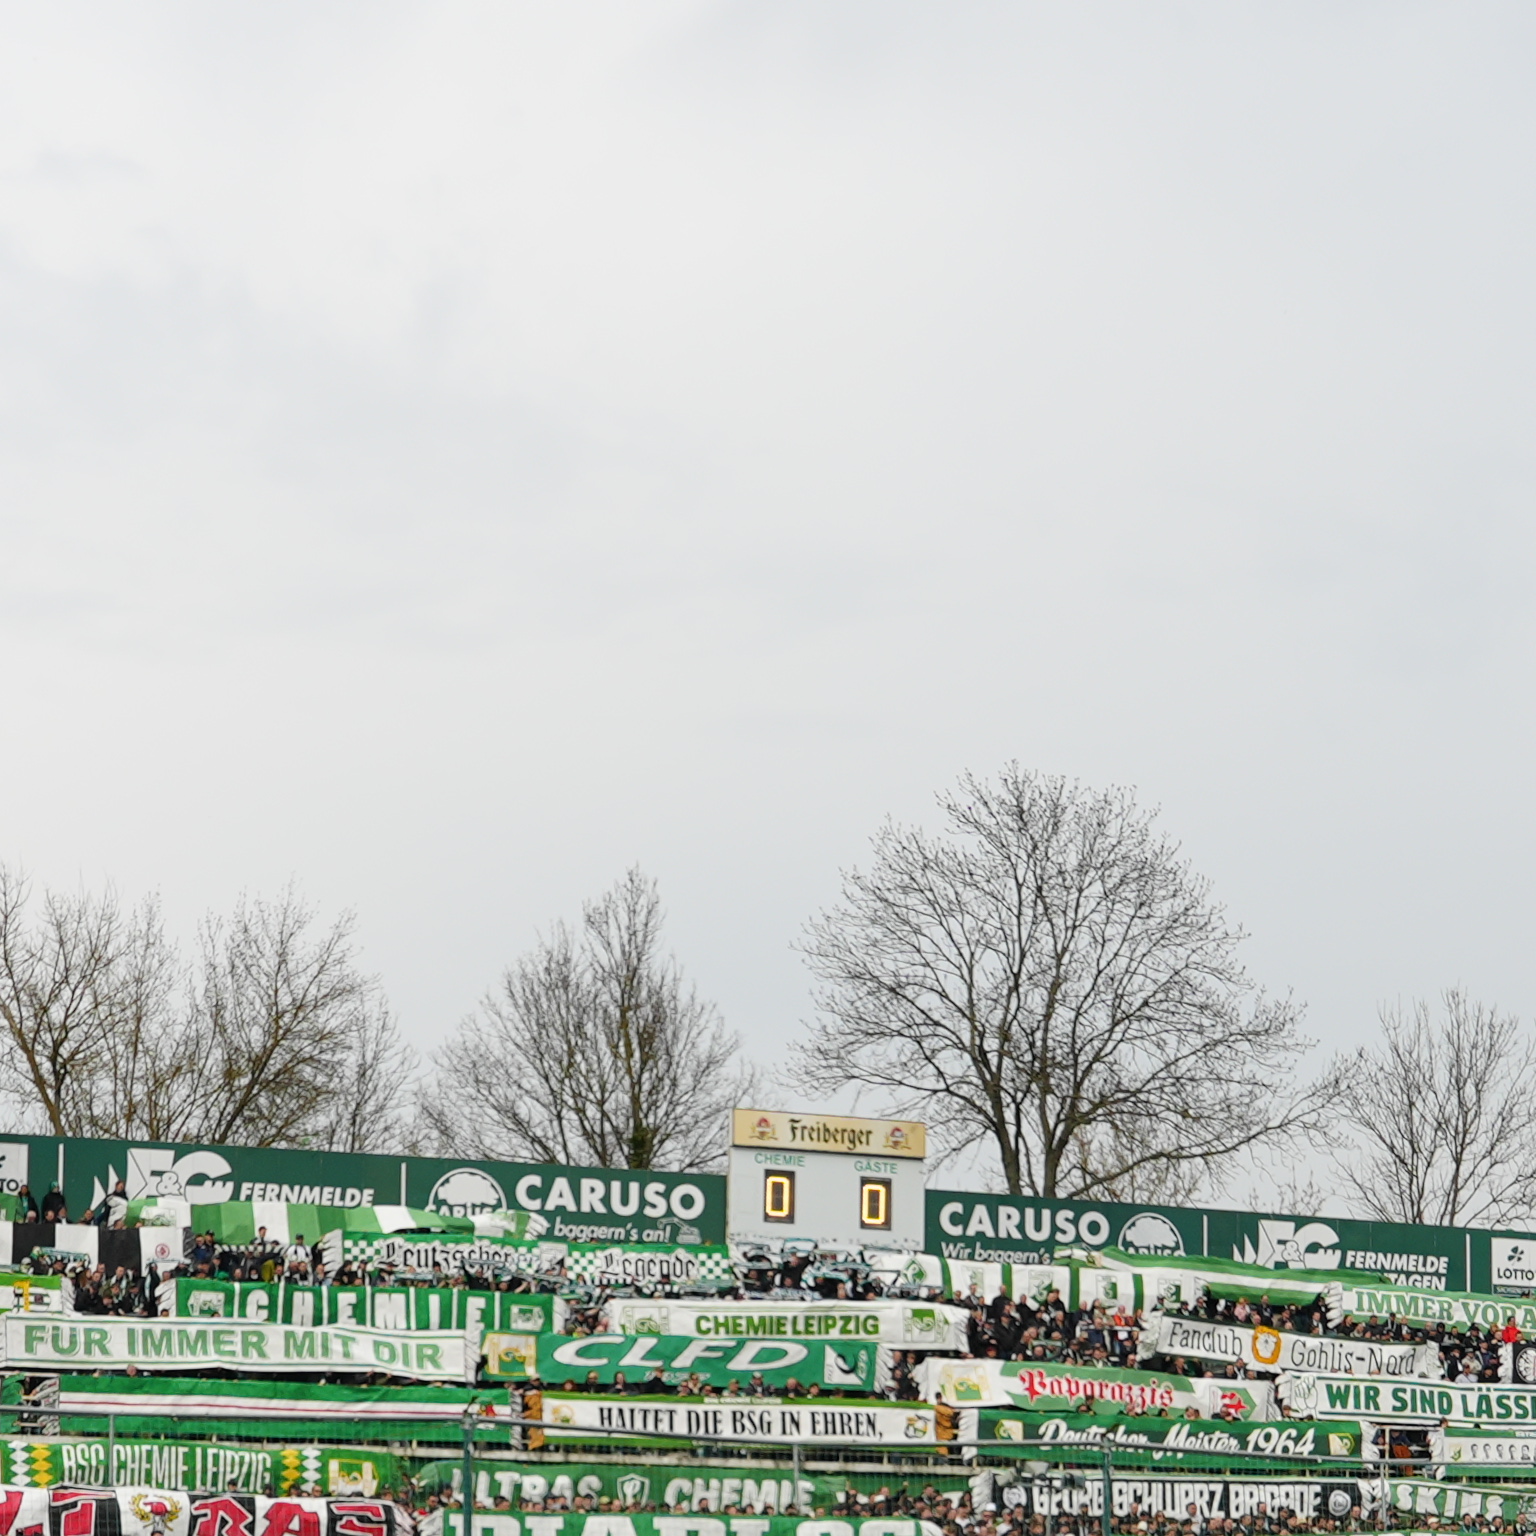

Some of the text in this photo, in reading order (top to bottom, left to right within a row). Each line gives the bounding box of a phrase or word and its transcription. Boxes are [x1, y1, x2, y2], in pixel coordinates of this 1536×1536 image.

[789, 1119, 873, 1149] Freiberger
[754, 1153, 805, 1167] CHEMIE
[854, 1158, 898, 1174] GÄSTE
[239, 1181, 374, 1208] FERNMELDE
[515, 1174, 705, 1220] CARUSO
[765, 1176, 790, 1217] 0
[861, 1183, 886, 1225] 0
[554, 1217, 671, 1243] baggern's an!
[939, 1202, 1110, 1245] CARUSO
[941, 1242, 1050, 1264] Wir baggern's
[1346, 1250, 1449, 1274] FERNMELDE
[1497, 1268, 1534, 1281] LOTTO
[1355, 1289, 1455, 1322] IMMER
[695, 1314, 880, 1337] CHEMIE LEIPZIG
[24, 1324, 443, 1370] FÜR IMMER MIT DIR
[552, 1334, 809, 1372] CLFD
[1168, 1321, 1417, 1375] Fanclub Gohlis-Nord
[1019, 1368, 1174, 1412] Paparazzis
[1325, 1383, 1380, 1410] WIR
[1391, 1388, 1452, 1416] SIND
[687, 1408, 722, 1435] DIE
[731, 1409, 772, 1436] BSG
[781, 1410, 801, 1436] IN
[809, 1411, 883, 1440] EHREN,
[1246, 1427, 1315, 1458] 1964
[61, 1443, 272, 1495] BSG CHEMIE LEIPZIG
[665, 1477, 815, 1515] CHEMIE
[1396, 1483, 1504, 1521] SKINS
